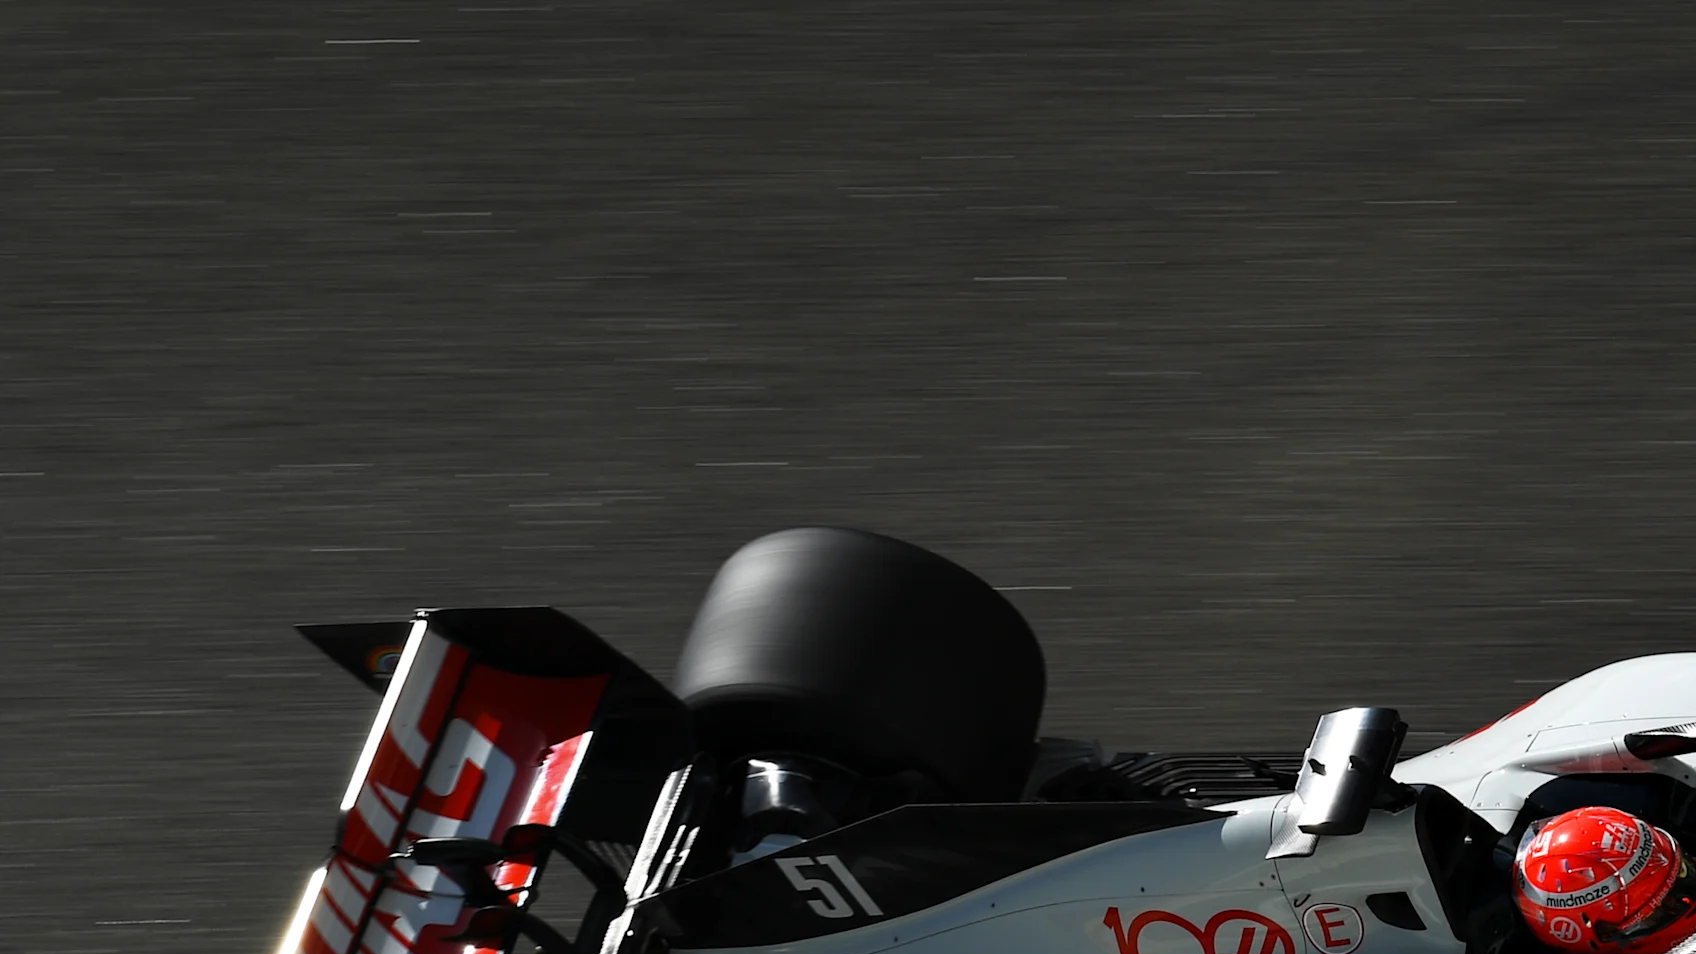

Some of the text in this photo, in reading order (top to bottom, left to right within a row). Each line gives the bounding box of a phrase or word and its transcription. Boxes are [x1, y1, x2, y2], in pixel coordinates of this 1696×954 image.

[773, 855, 883, 918] 51
[1546, 885, 1610, 908] mindmaze
[1314, 908, 1351, 948] E
